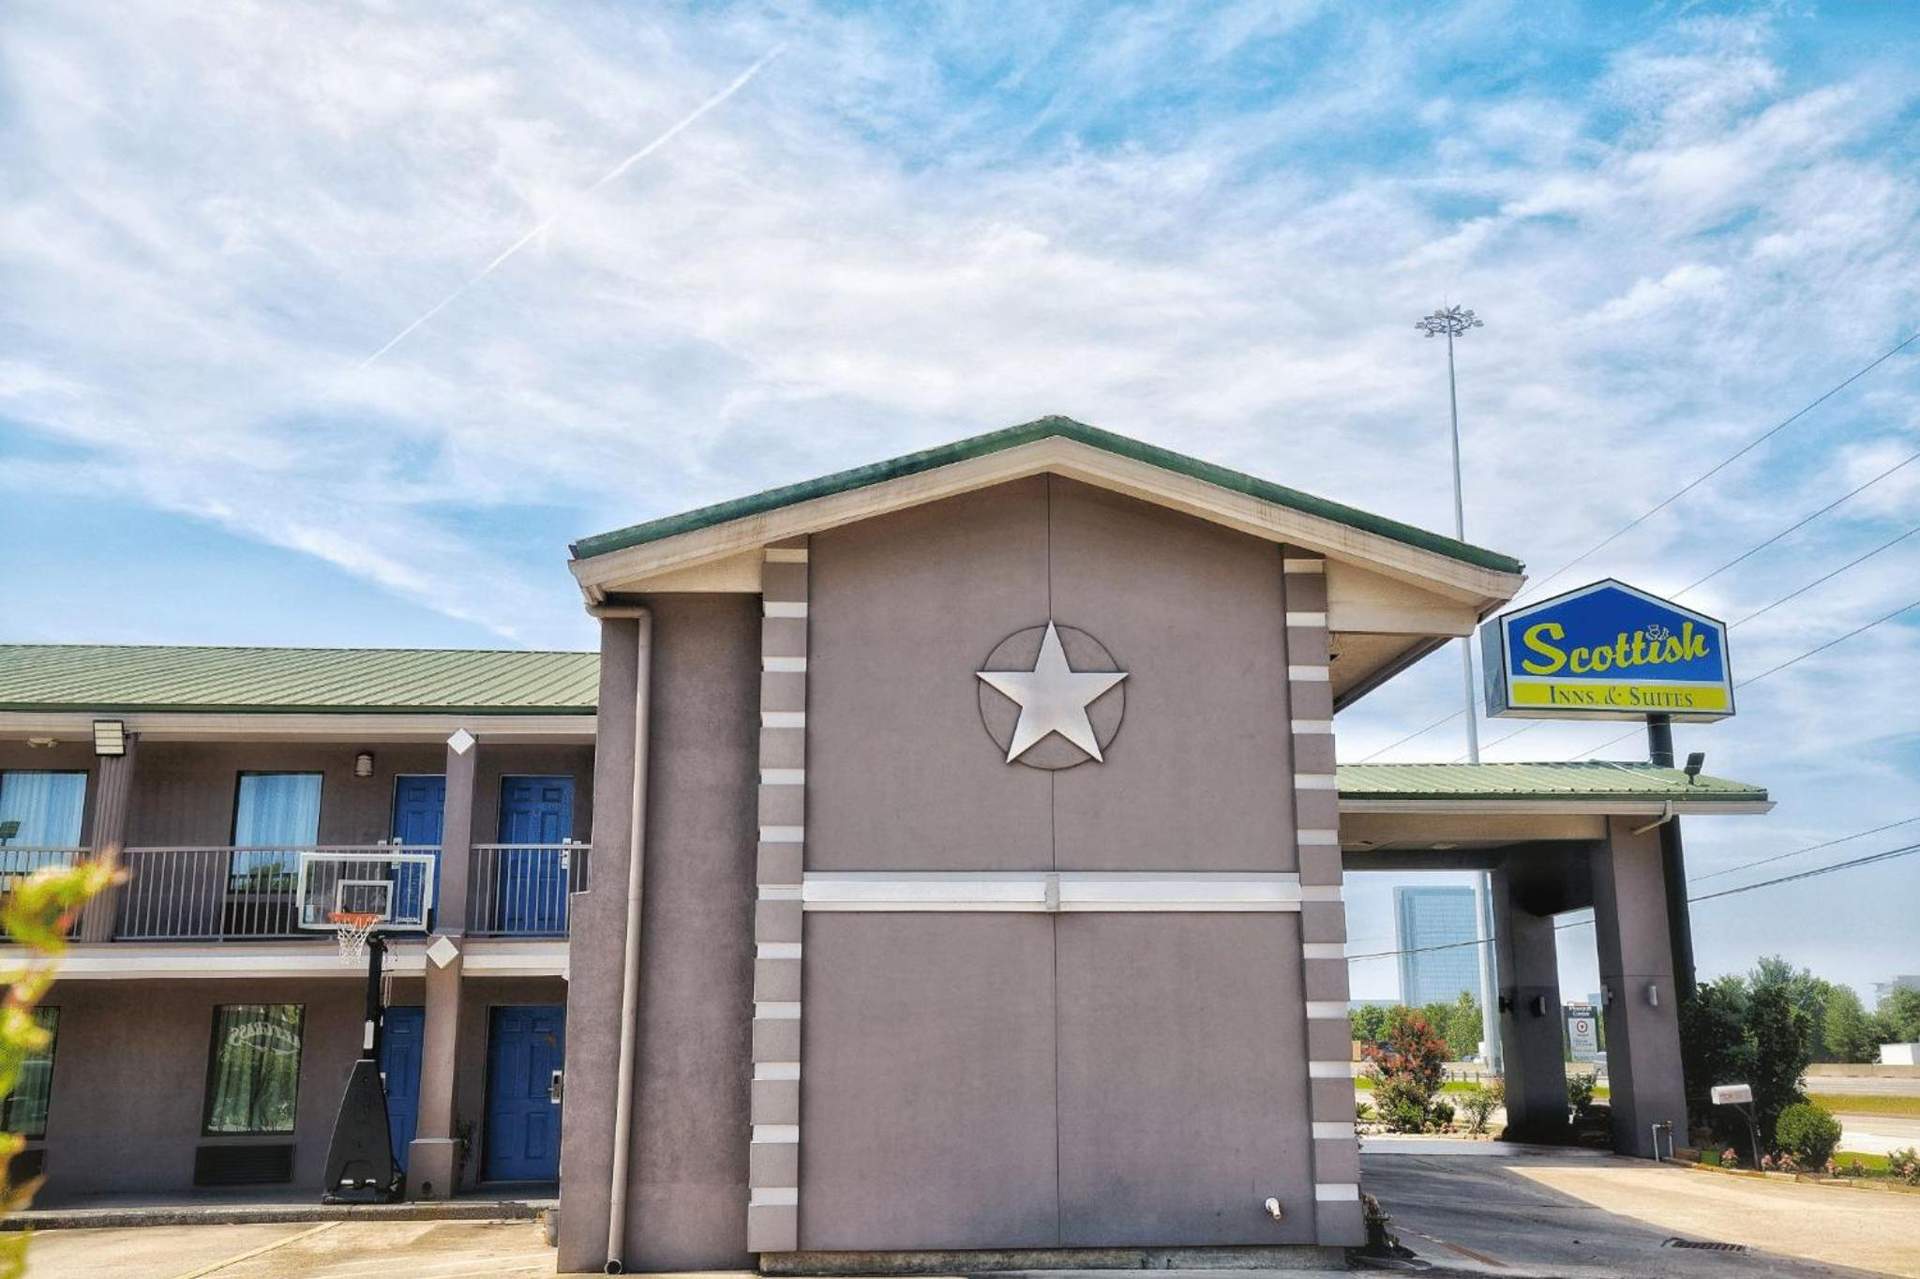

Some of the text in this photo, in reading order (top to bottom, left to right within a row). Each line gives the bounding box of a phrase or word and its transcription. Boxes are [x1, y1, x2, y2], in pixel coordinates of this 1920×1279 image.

[1521, 621, 1710, 676] Scottish
[1549, 685, 1694, 707] INNS & SUITES
